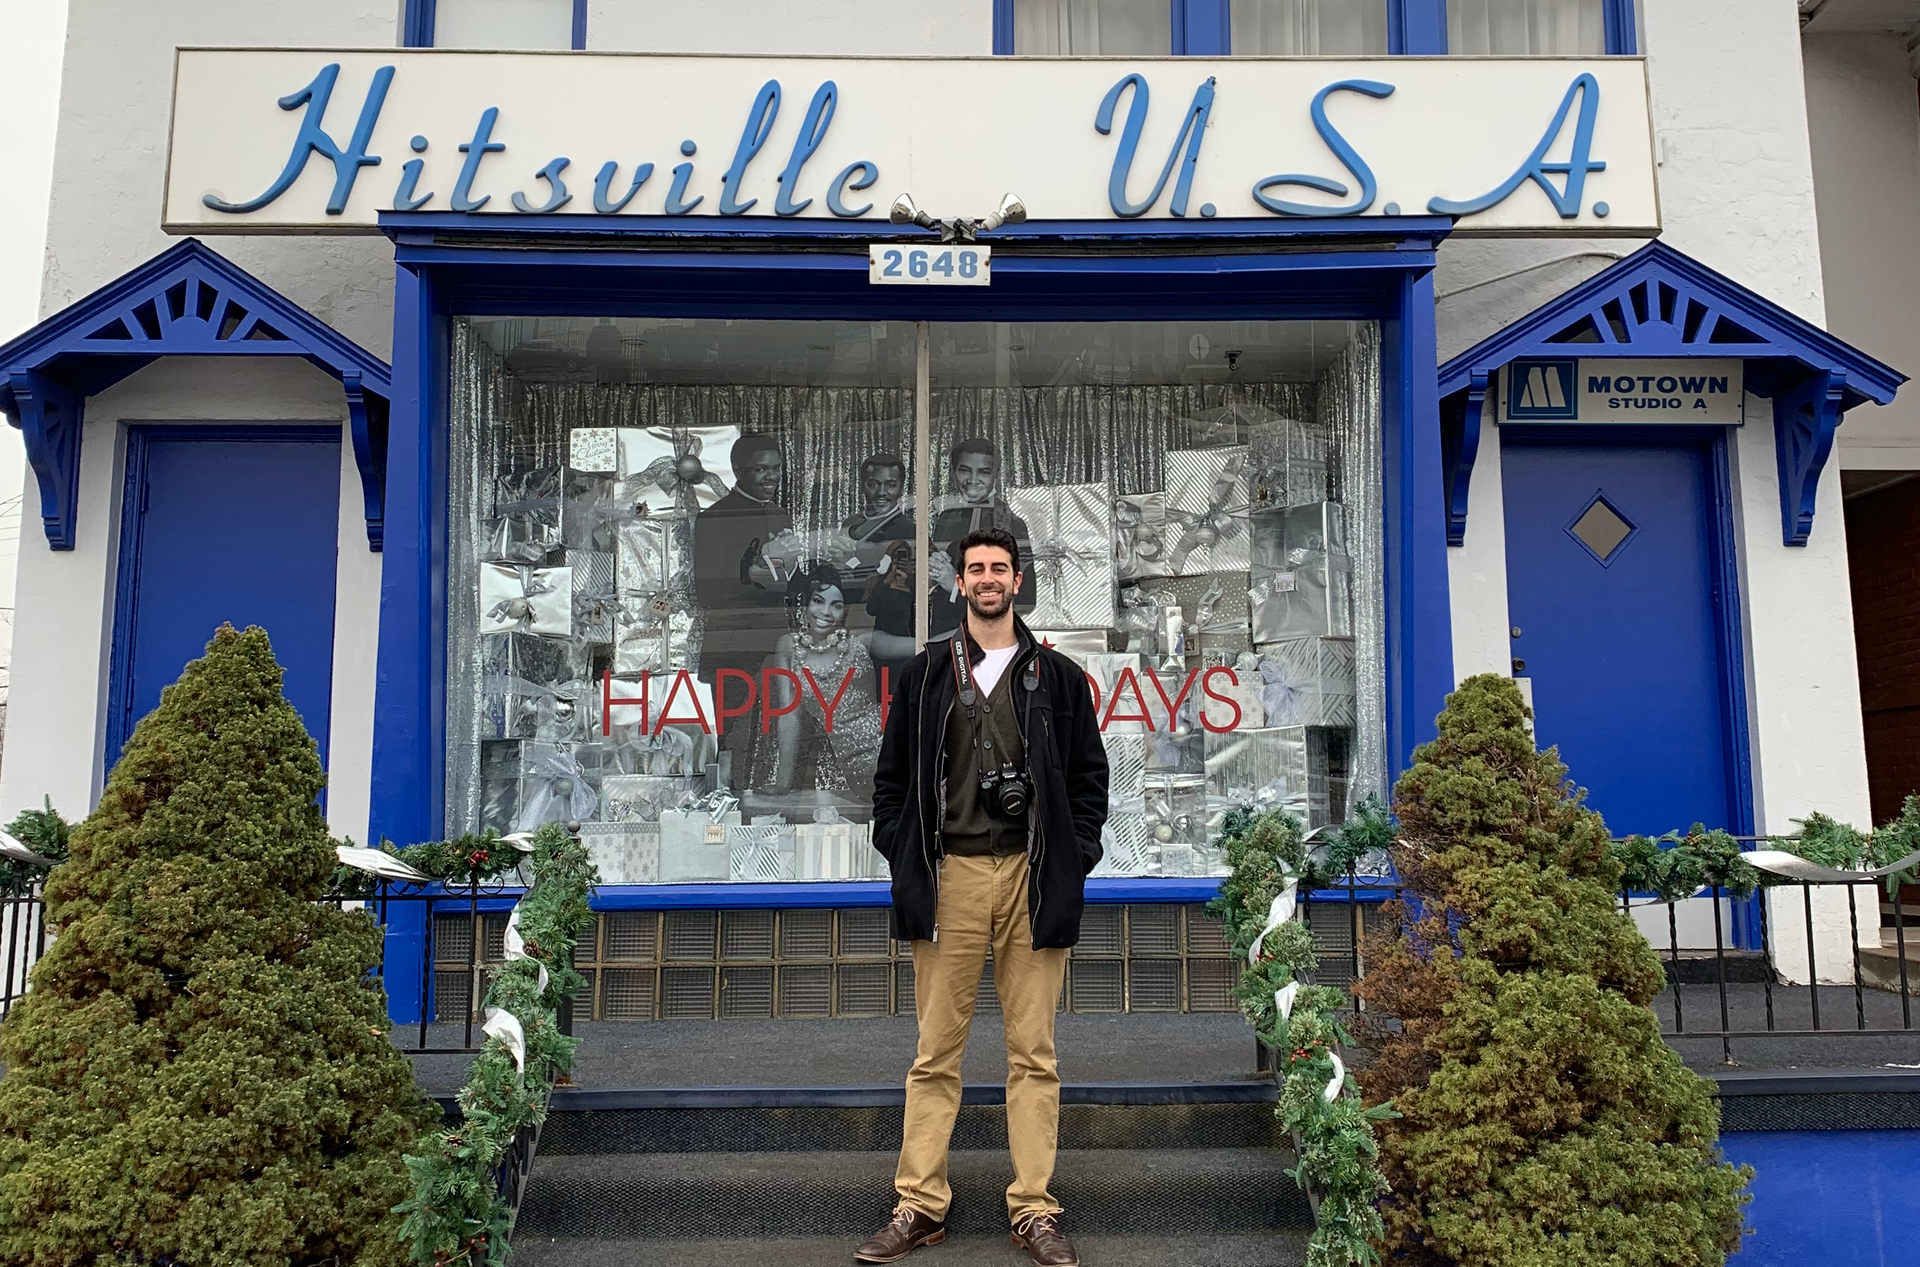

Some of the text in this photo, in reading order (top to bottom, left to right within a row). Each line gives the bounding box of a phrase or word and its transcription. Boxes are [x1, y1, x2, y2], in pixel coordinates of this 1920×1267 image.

[202, 62, 1610, 219] Hitsville U.S.A.
[882, 249, 979, 279] 2648
[1587, 375, 1729, 394] MOTOWN
[1607, 397, 1709, 410] STUDIO A
[955, 641, 968, 685] EOS DIGITAL
[602, 667, 857, 736] HAPPY
